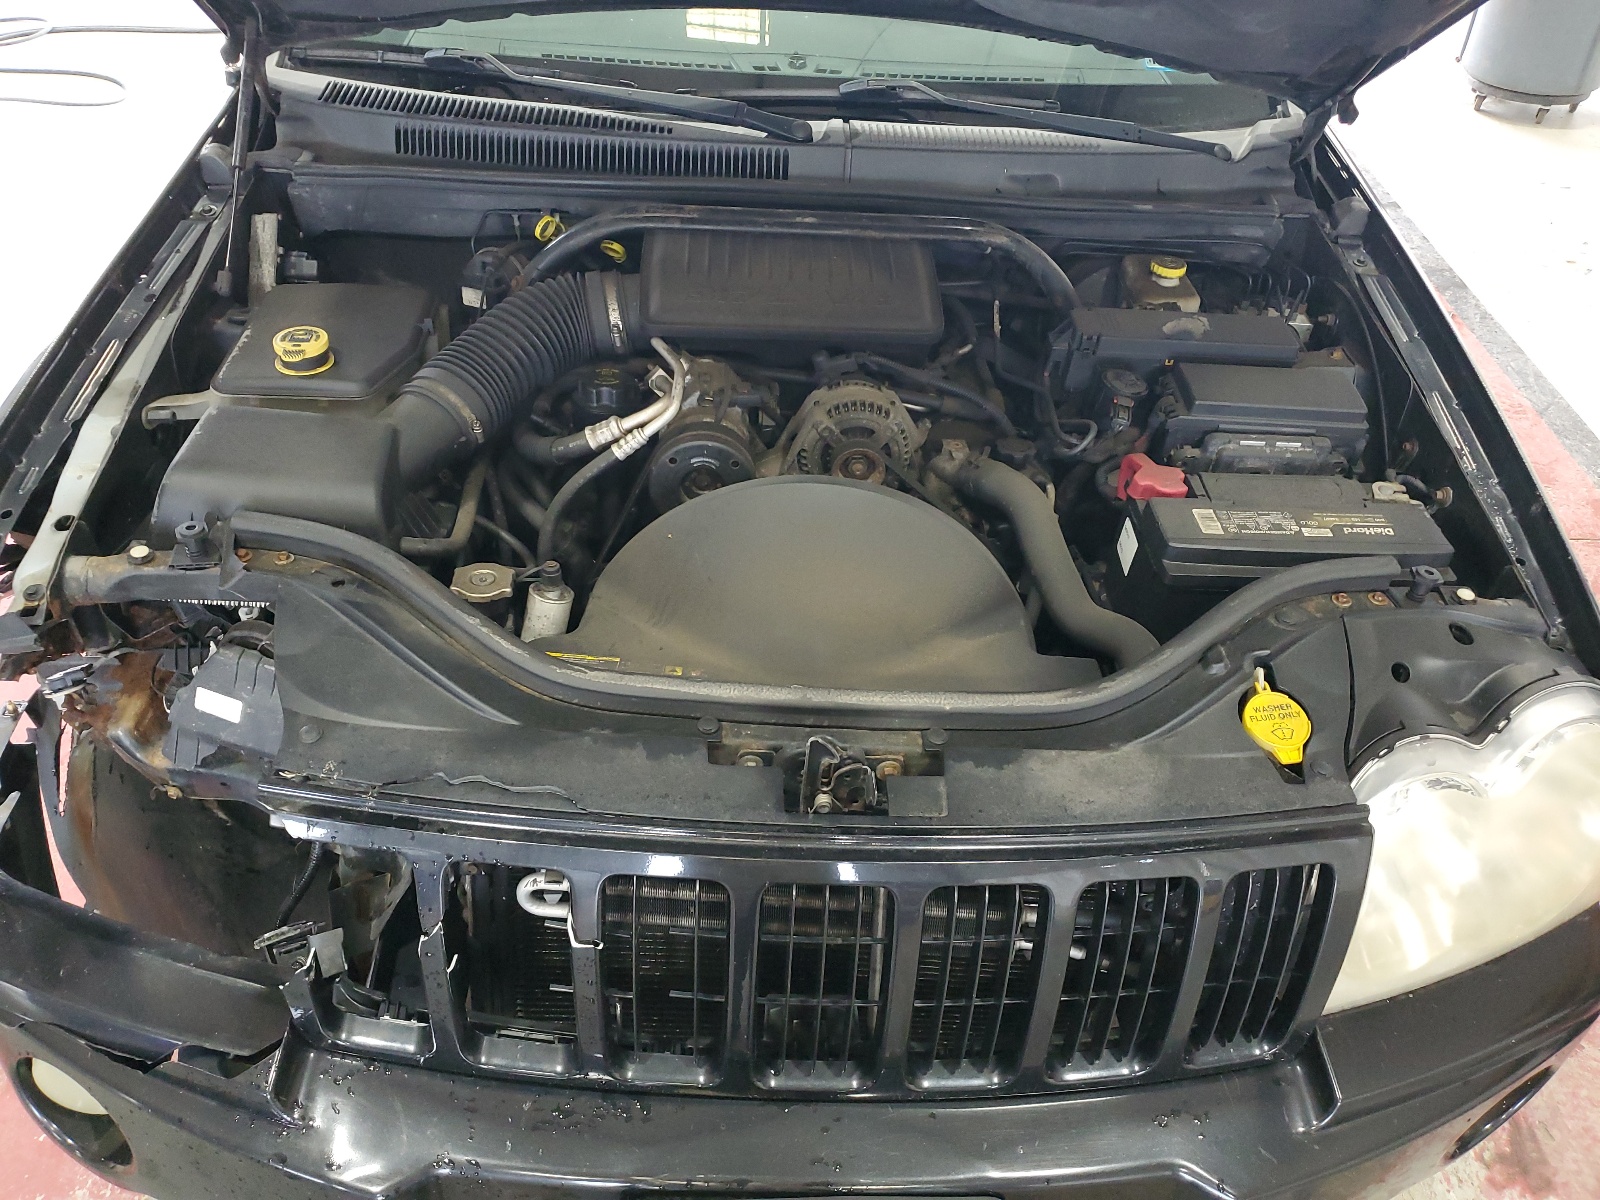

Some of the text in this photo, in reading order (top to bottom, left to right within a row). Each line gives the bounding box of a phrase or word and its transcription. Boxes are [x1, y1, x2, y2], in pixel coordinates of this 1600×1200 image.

[1343, 527, 1395, 536] DieHard
[1252, 703, 1293, 714] WASHER
[1249, 710, 1301, 723] FLUID ONLY
